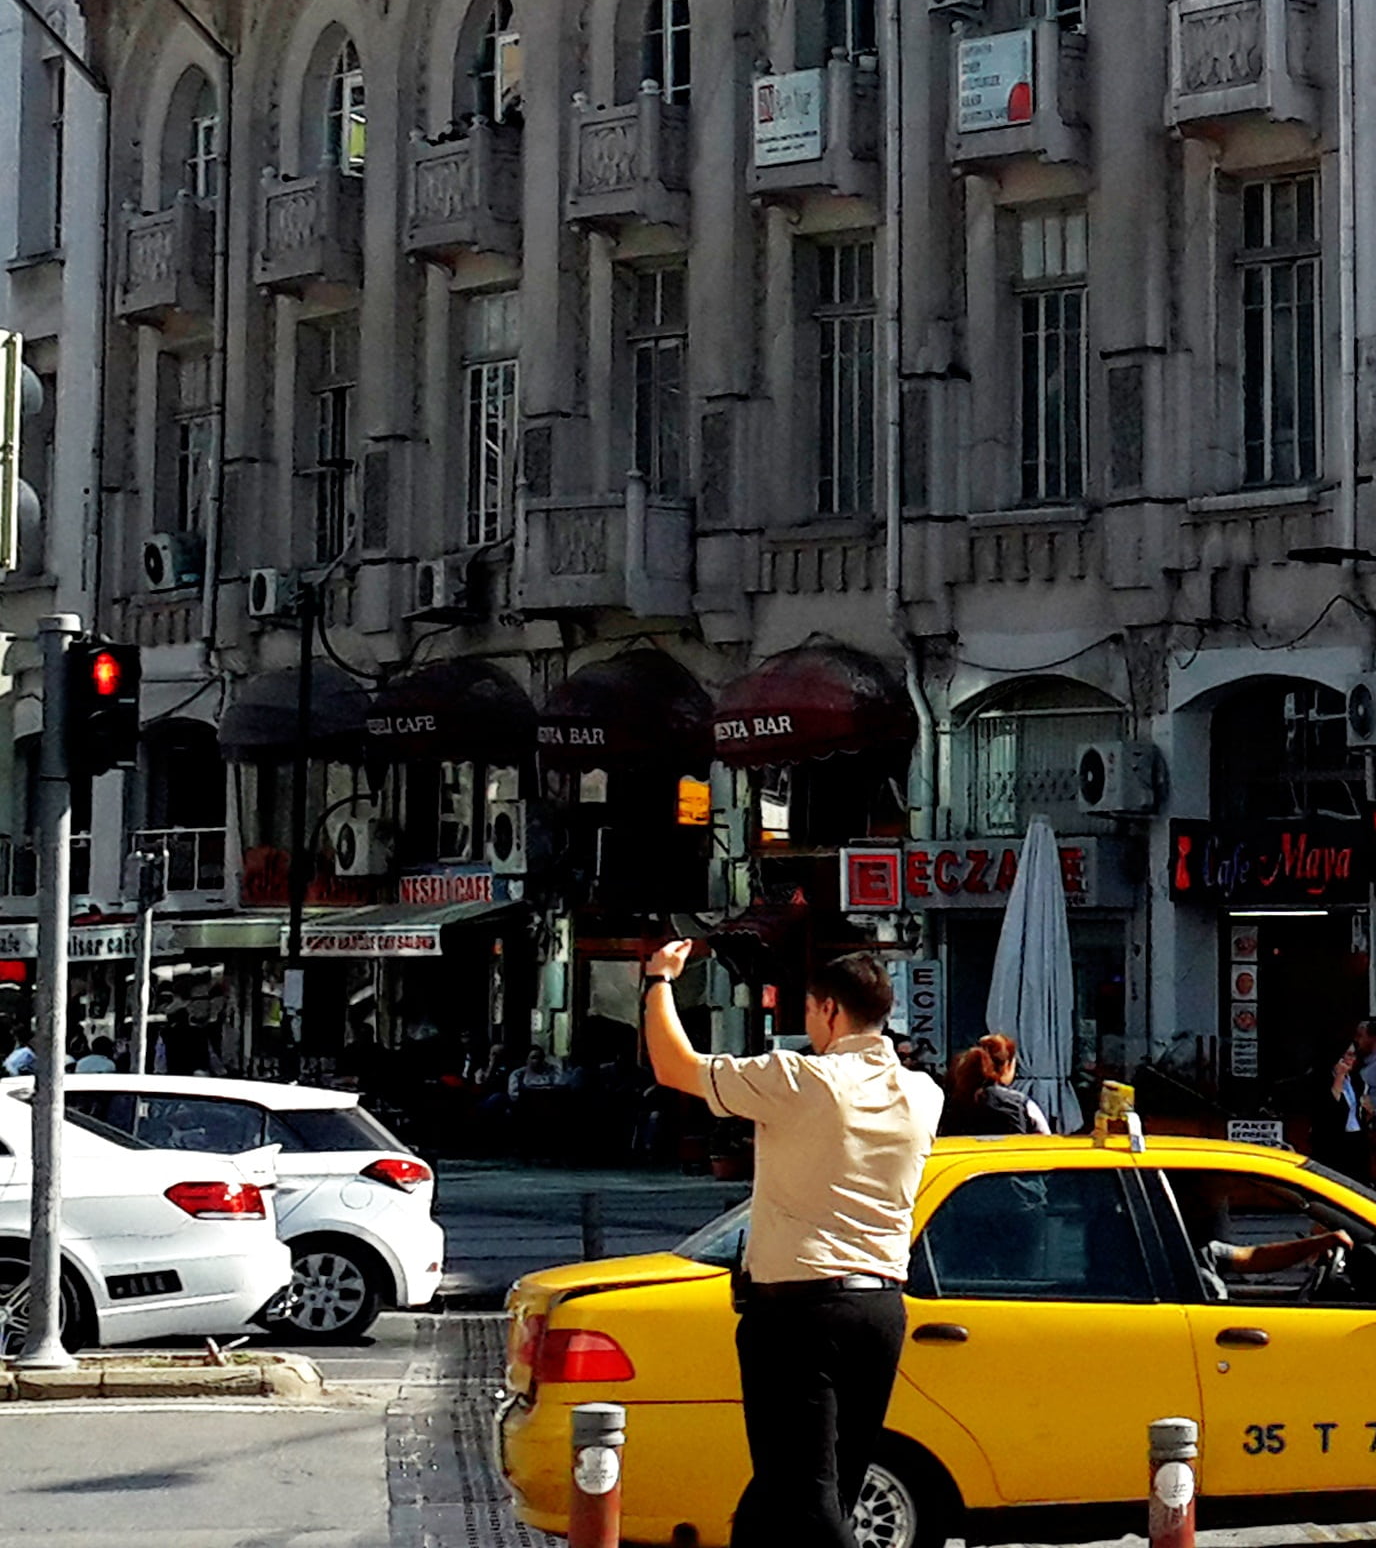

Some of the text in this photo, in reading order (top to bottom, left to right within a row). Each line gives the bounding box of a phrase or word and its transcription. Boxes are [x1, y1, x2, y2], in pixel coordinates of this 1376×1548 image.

[569, 727, 605, 745] BAR
[753, 715, 793, 736] BAR
[906, 849, 1088, 898] ECZAE
[1260, 832, 1353, 895] Maya
[1243, 1423, 1286, 1455] 35
[1313, 1422, 1339, 1453] T
